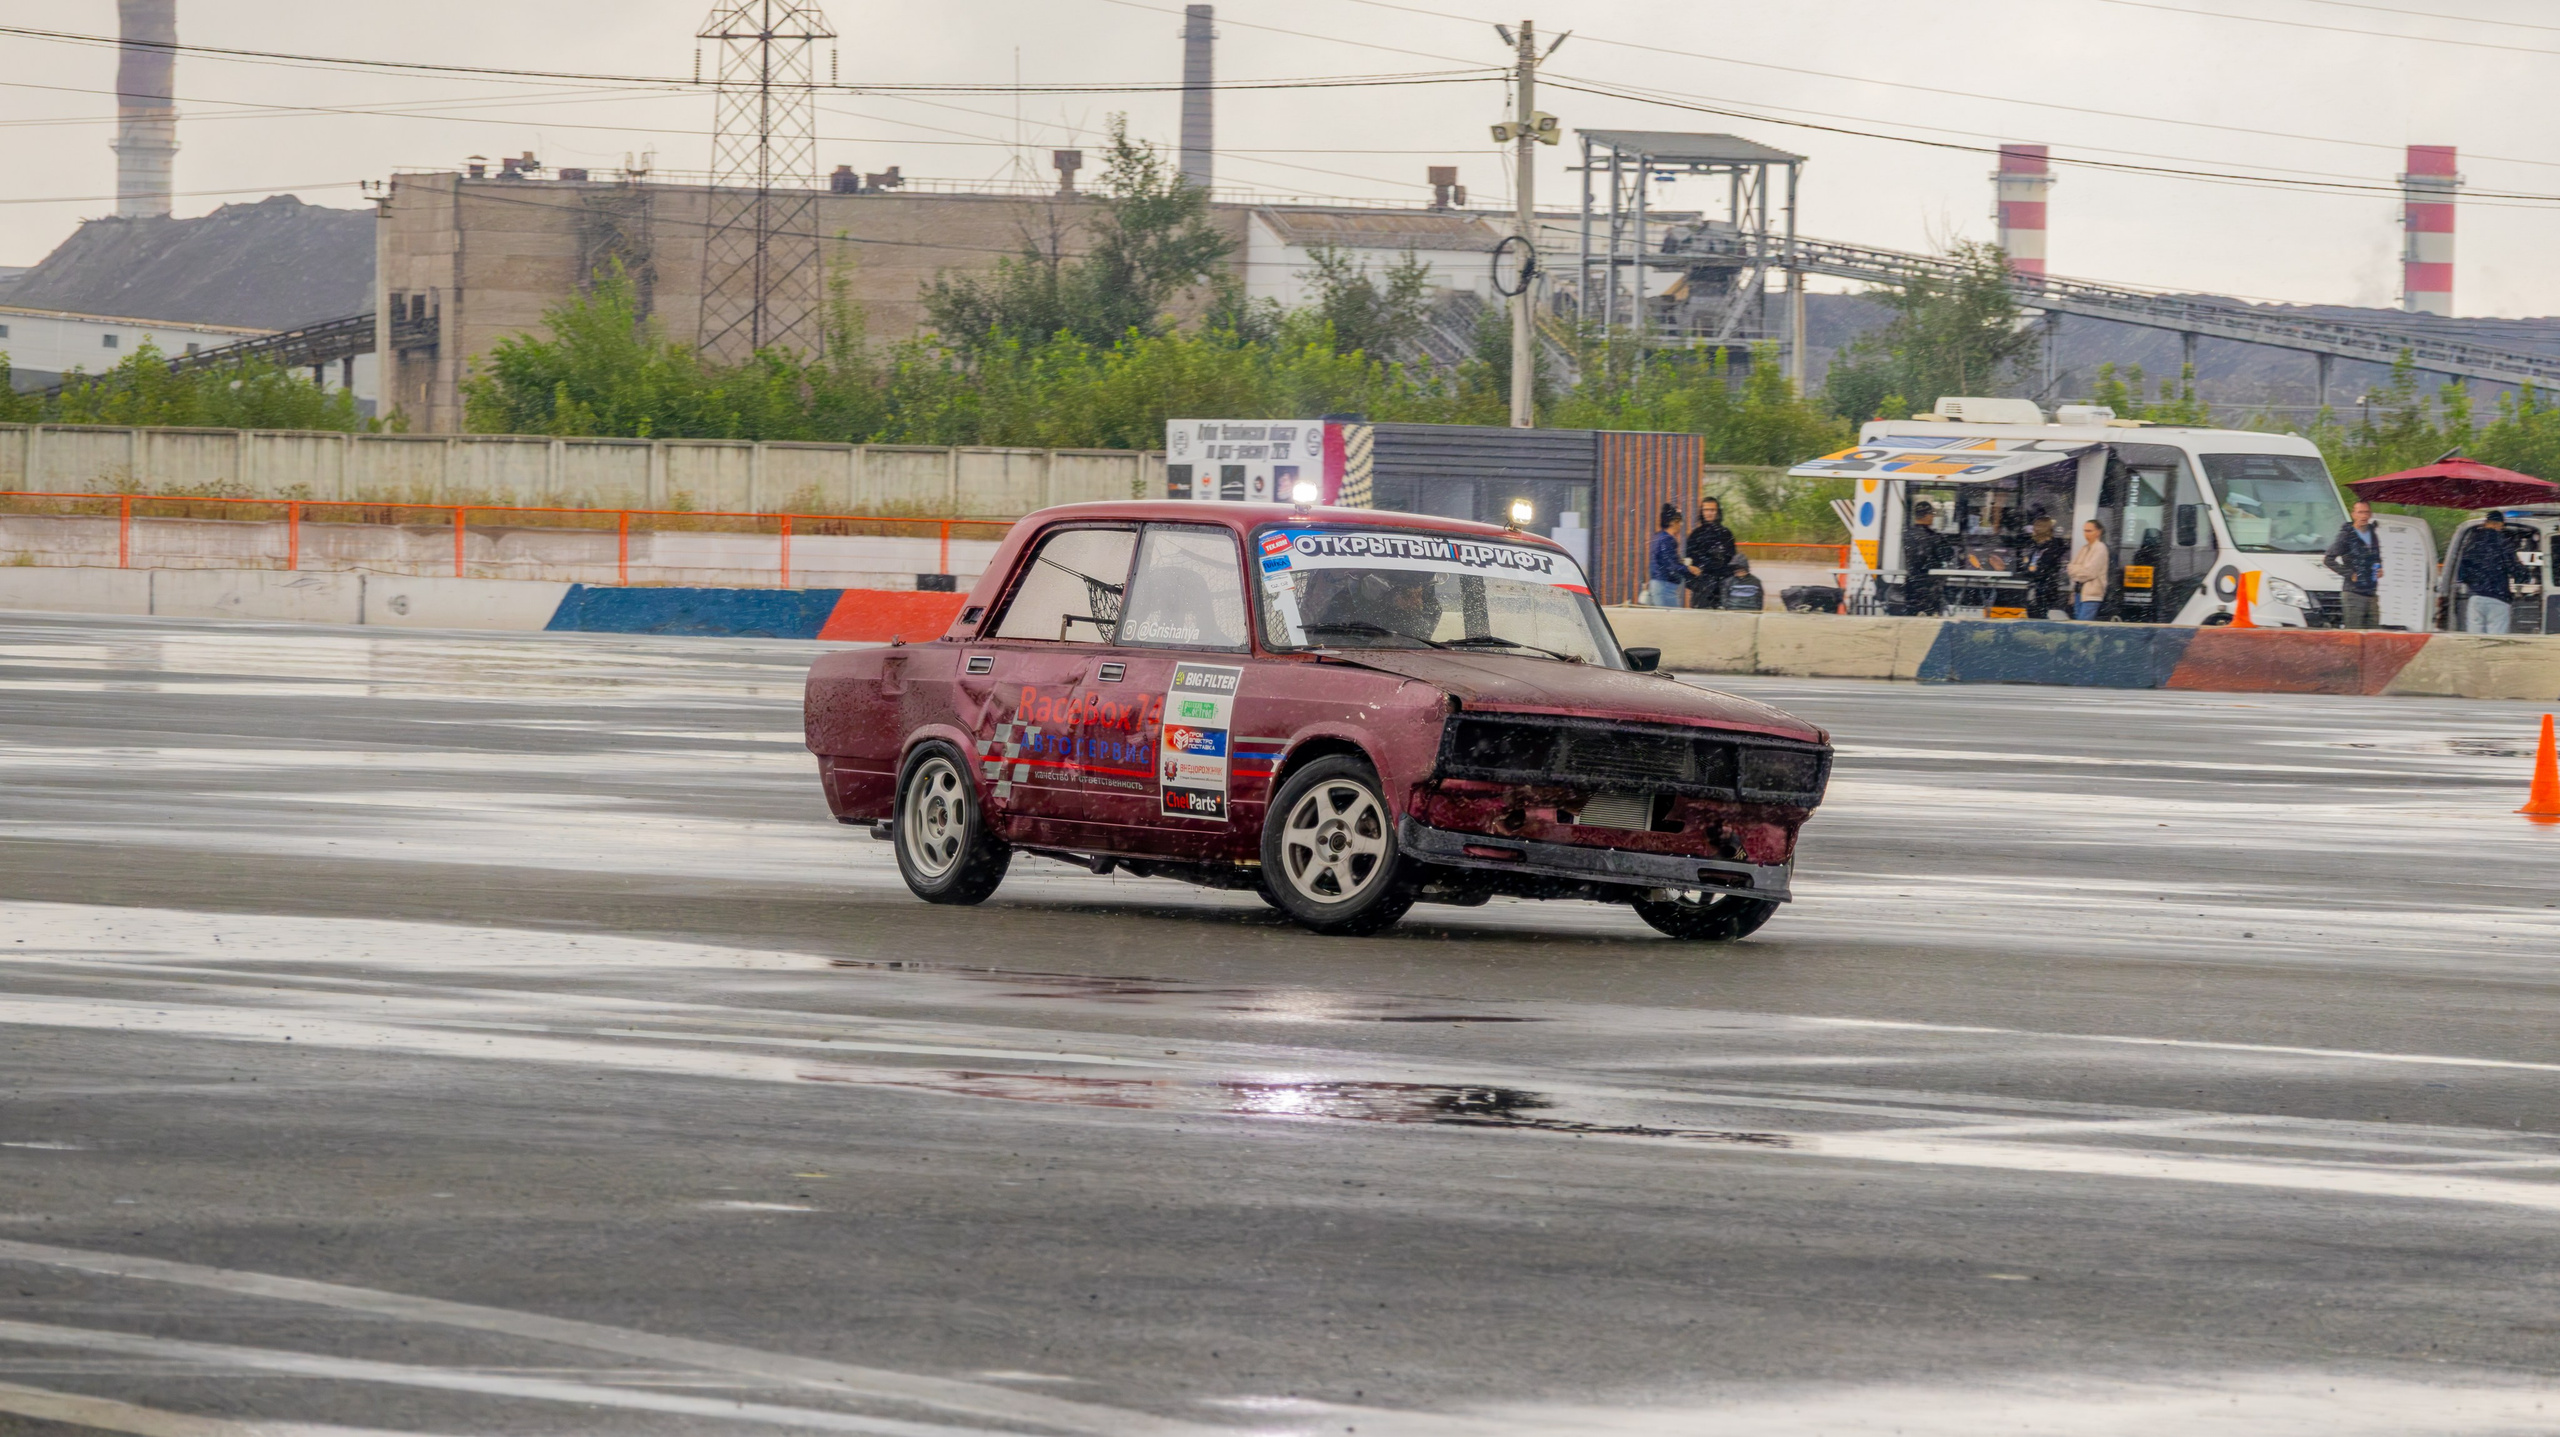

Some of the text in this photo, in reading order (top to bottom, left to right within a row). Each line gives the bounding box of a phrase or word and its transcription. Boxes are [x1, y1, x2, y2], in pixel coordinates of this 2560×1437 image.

[1295, 536, 1452, 561] ОТКРЫТЫЙ
[1459, 544, 1552, 573] ДРИФТ
[1138, 622, 1200, 643] @Grishanya
[1185, 672, 1237, 690] BIG FILTER
[1018, 686, 1132, 731] RaceBox
[1020, 732, 1150, 765] АВТОСЕРВИС
[1188, 743, 1215, 751] ПОСТАВКА
[1034, 770, 1144, 790] качество и ответственность
[1166, 790, 1217, 812] ChelParts
